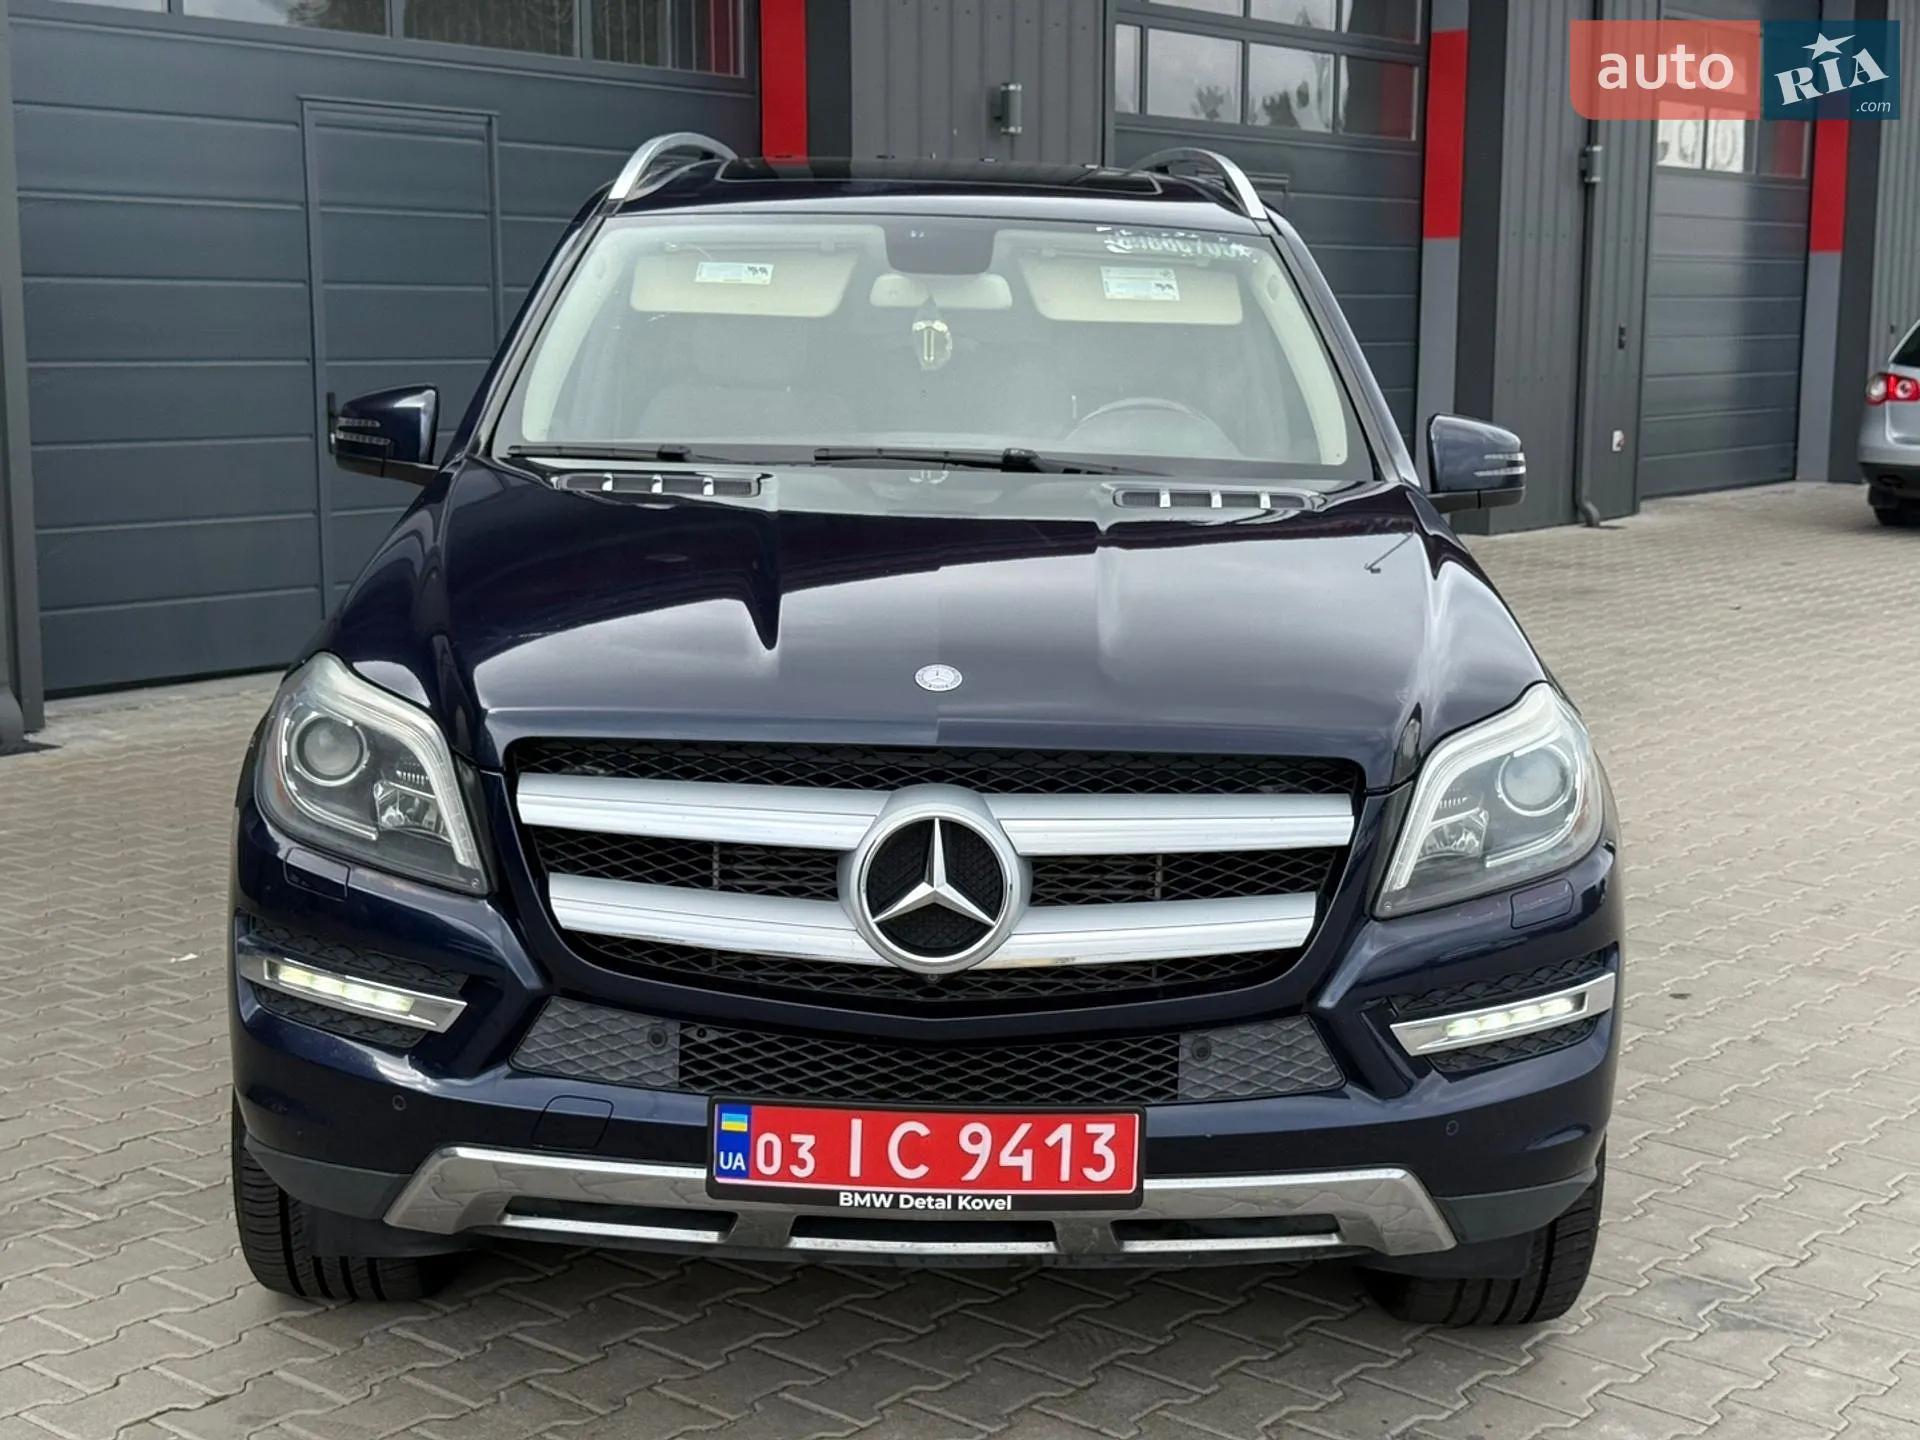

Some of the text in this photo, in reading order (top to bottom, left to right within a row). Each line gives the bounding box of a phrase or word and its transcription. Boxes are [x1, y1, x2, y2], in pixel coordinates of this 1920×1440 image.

[719, 1152, 746, 1171] UA
[755, 1132, 816, 1178] 03
[957, 1122, 1117, 1183] 9413
[839, 1192, 1012, 1212] BMW Detal Kovel
